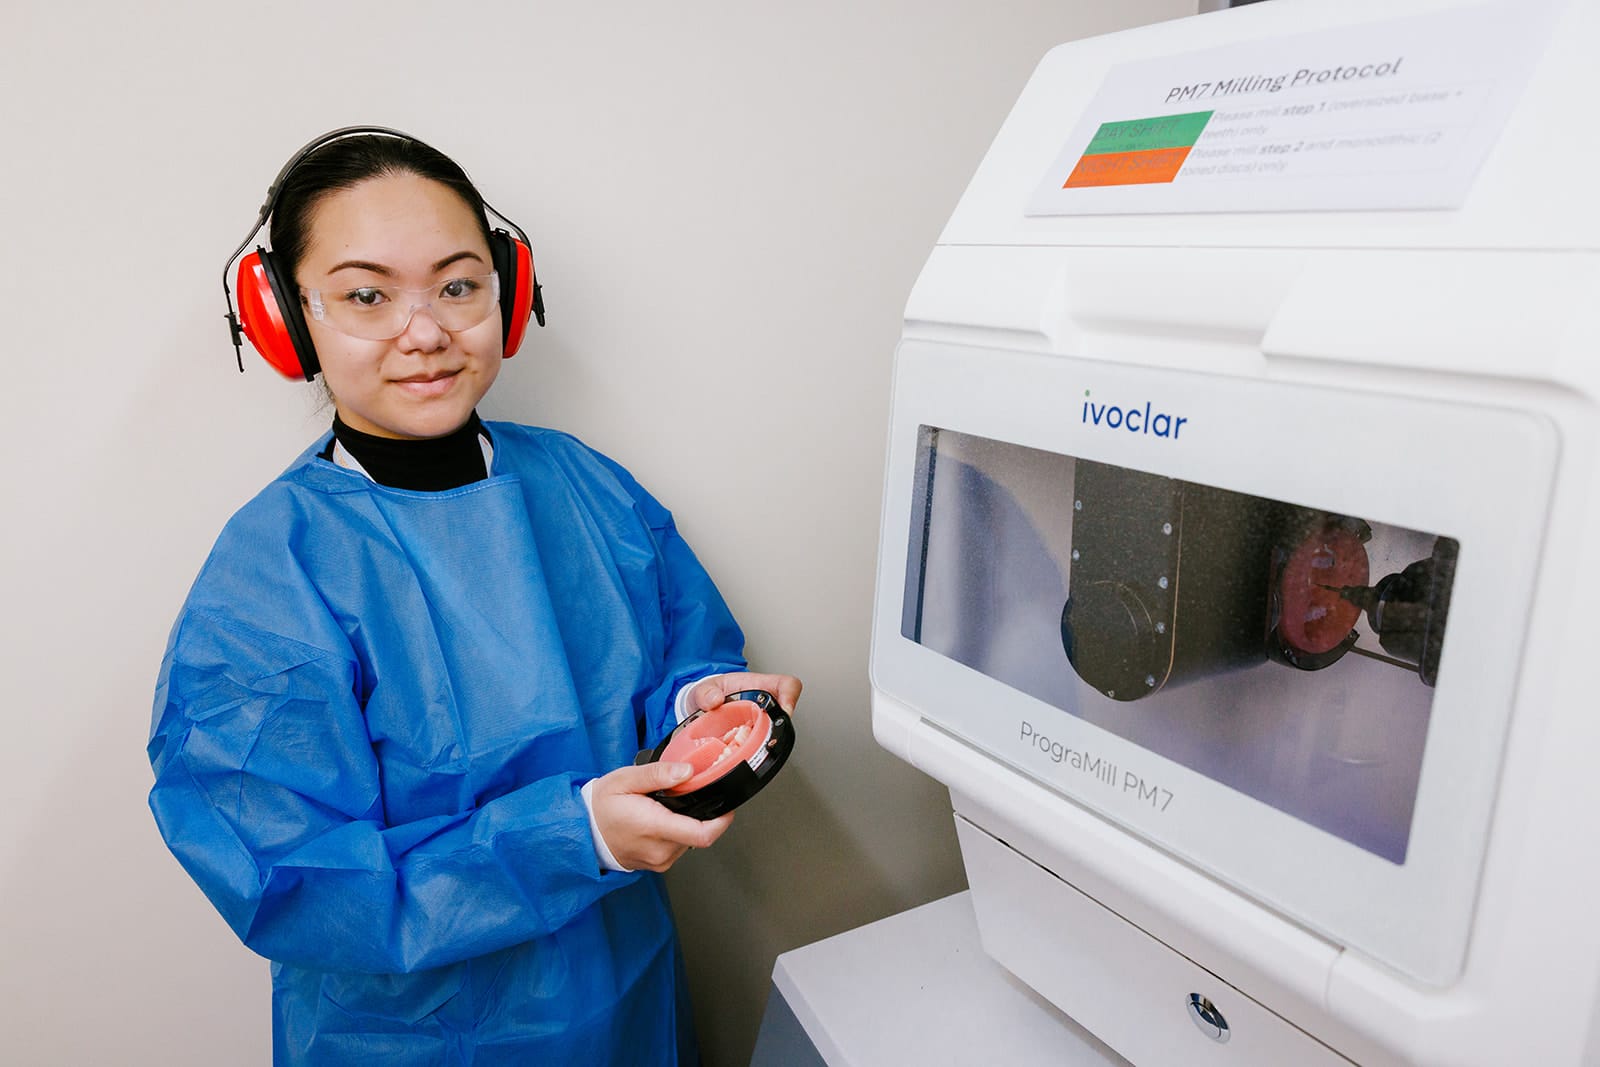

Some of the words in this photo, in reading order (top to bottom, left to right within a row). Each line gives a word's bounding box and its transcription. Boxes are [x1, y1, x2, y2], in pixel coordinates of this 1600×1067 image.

[1165, 82, 1211, 103] PM7
[1211, 73, 1287, 97] Milling
[1290, 56, 1403, 87] Protocol
[1282, 104, 1315, 116] step
[1258, 143, 1292, 156] step
[1082, 389, 1187, 439] ivoclar
[1020, 721, 1118, 787] PrograMill
[1123, 771, 1174, 812] PM7
